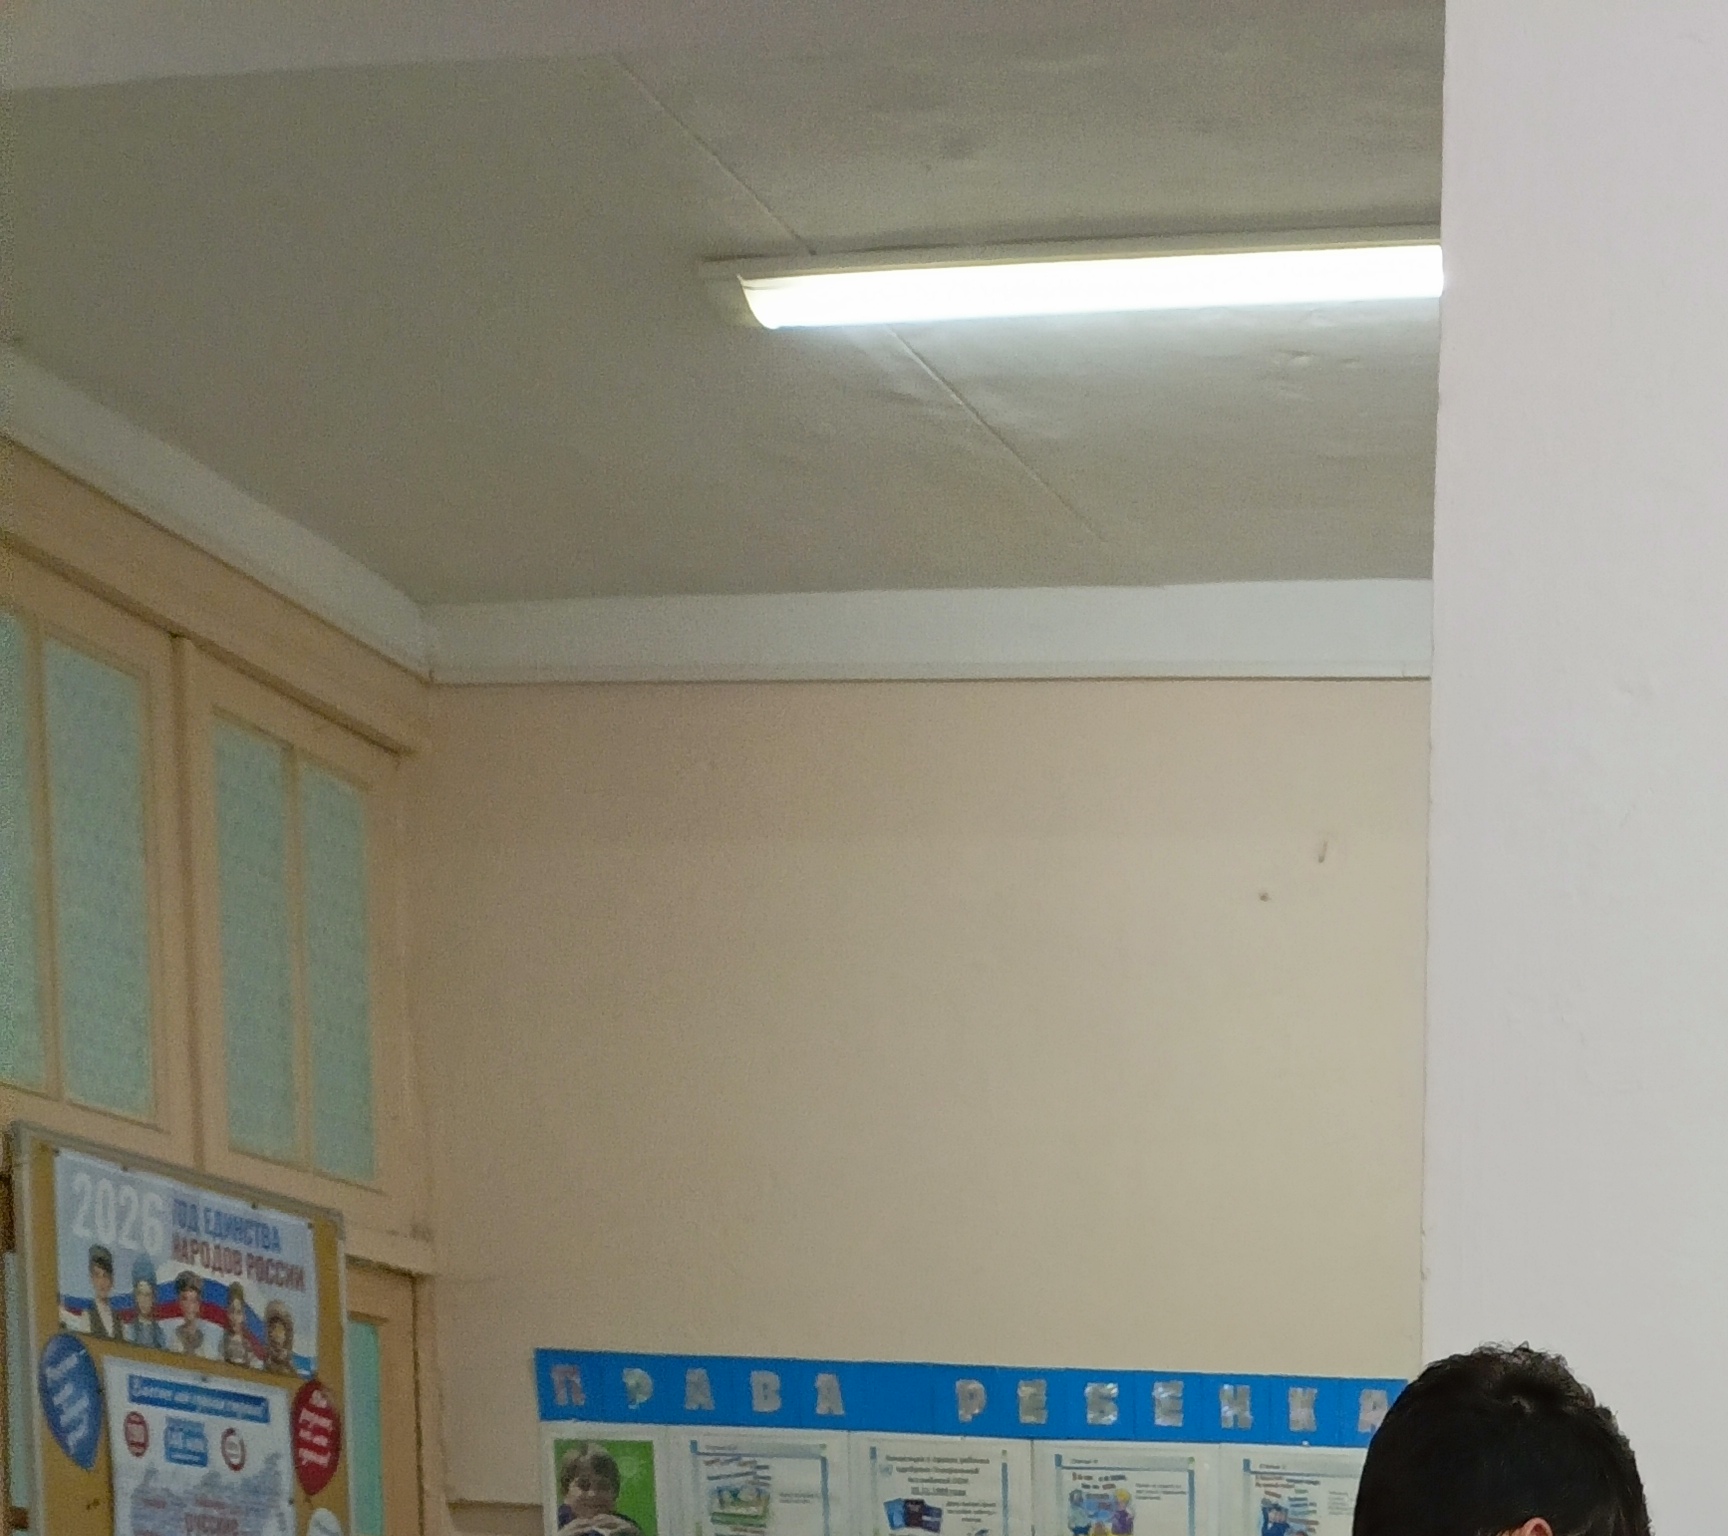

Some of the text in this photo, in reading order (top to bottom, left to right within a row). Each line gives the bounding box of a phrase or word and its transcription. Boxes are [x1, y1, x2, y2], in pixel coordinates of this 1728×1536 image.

[203, 1207, 281, 1253] ЕДИНСТВА
[171, 1232, 243, 1277] НАРОДОВ
[550, 1364, 845, 1417] ПРАВА
